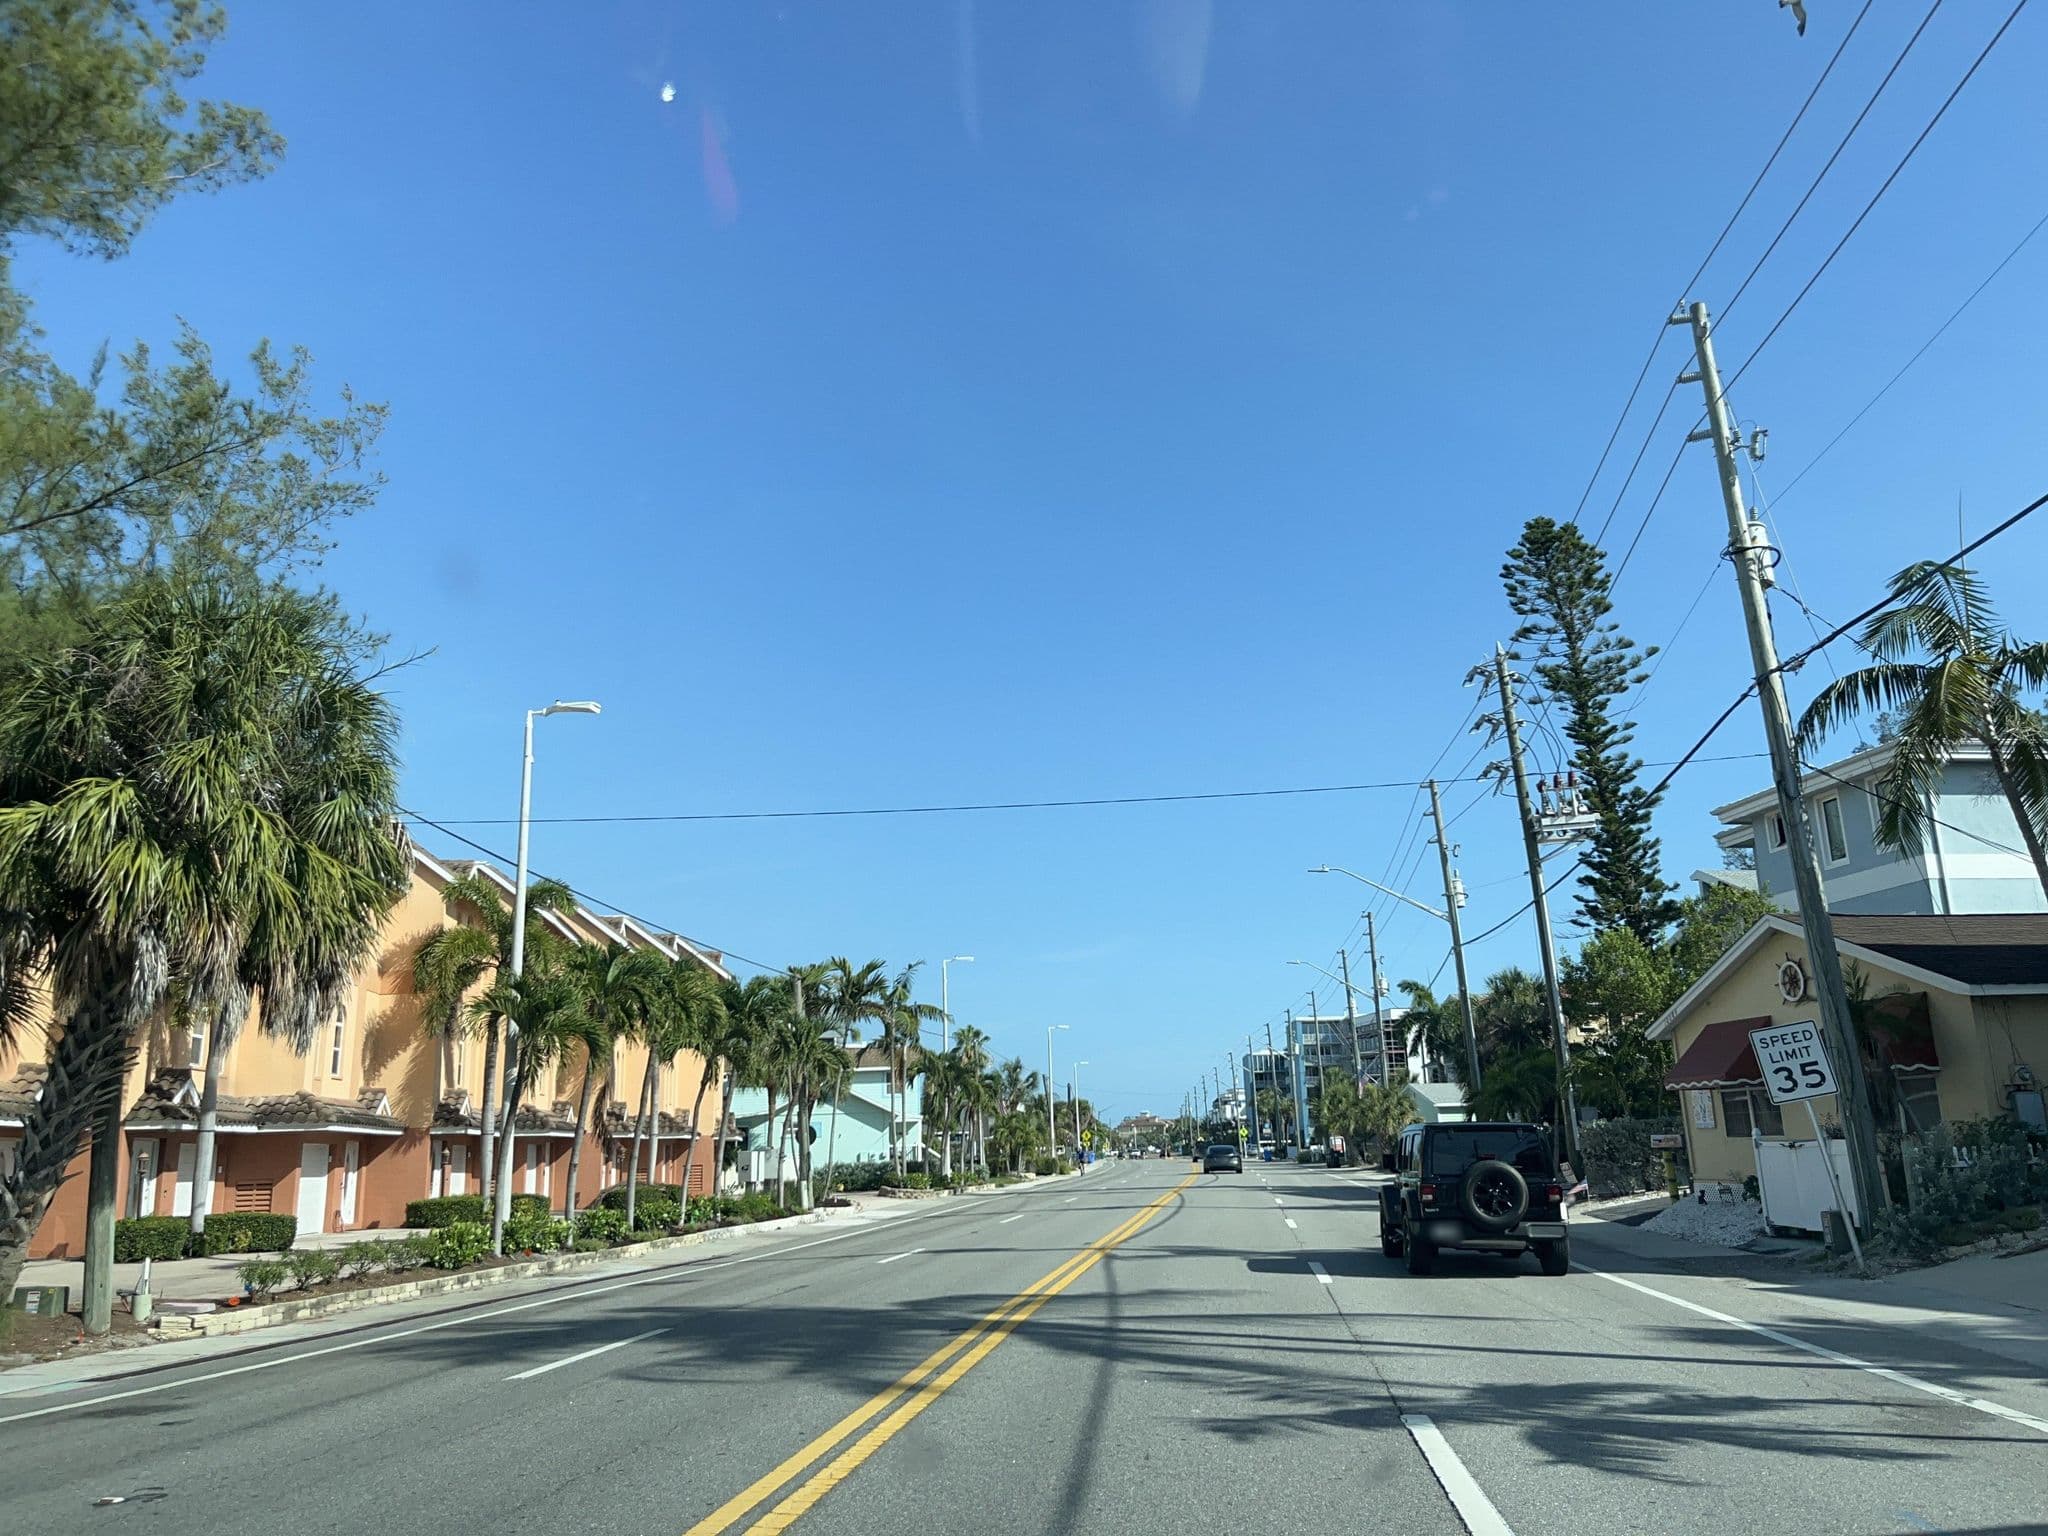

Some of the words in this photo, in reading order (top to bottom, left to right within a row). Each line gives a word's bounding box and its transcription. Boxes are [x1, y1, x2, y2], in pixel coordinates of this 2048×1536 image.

[1759, 1029, 1813, 1049] SPEED
[1768, 1046, 1811, 1064] LIMIT
[1772, 1060, 1826, 1093] 35
